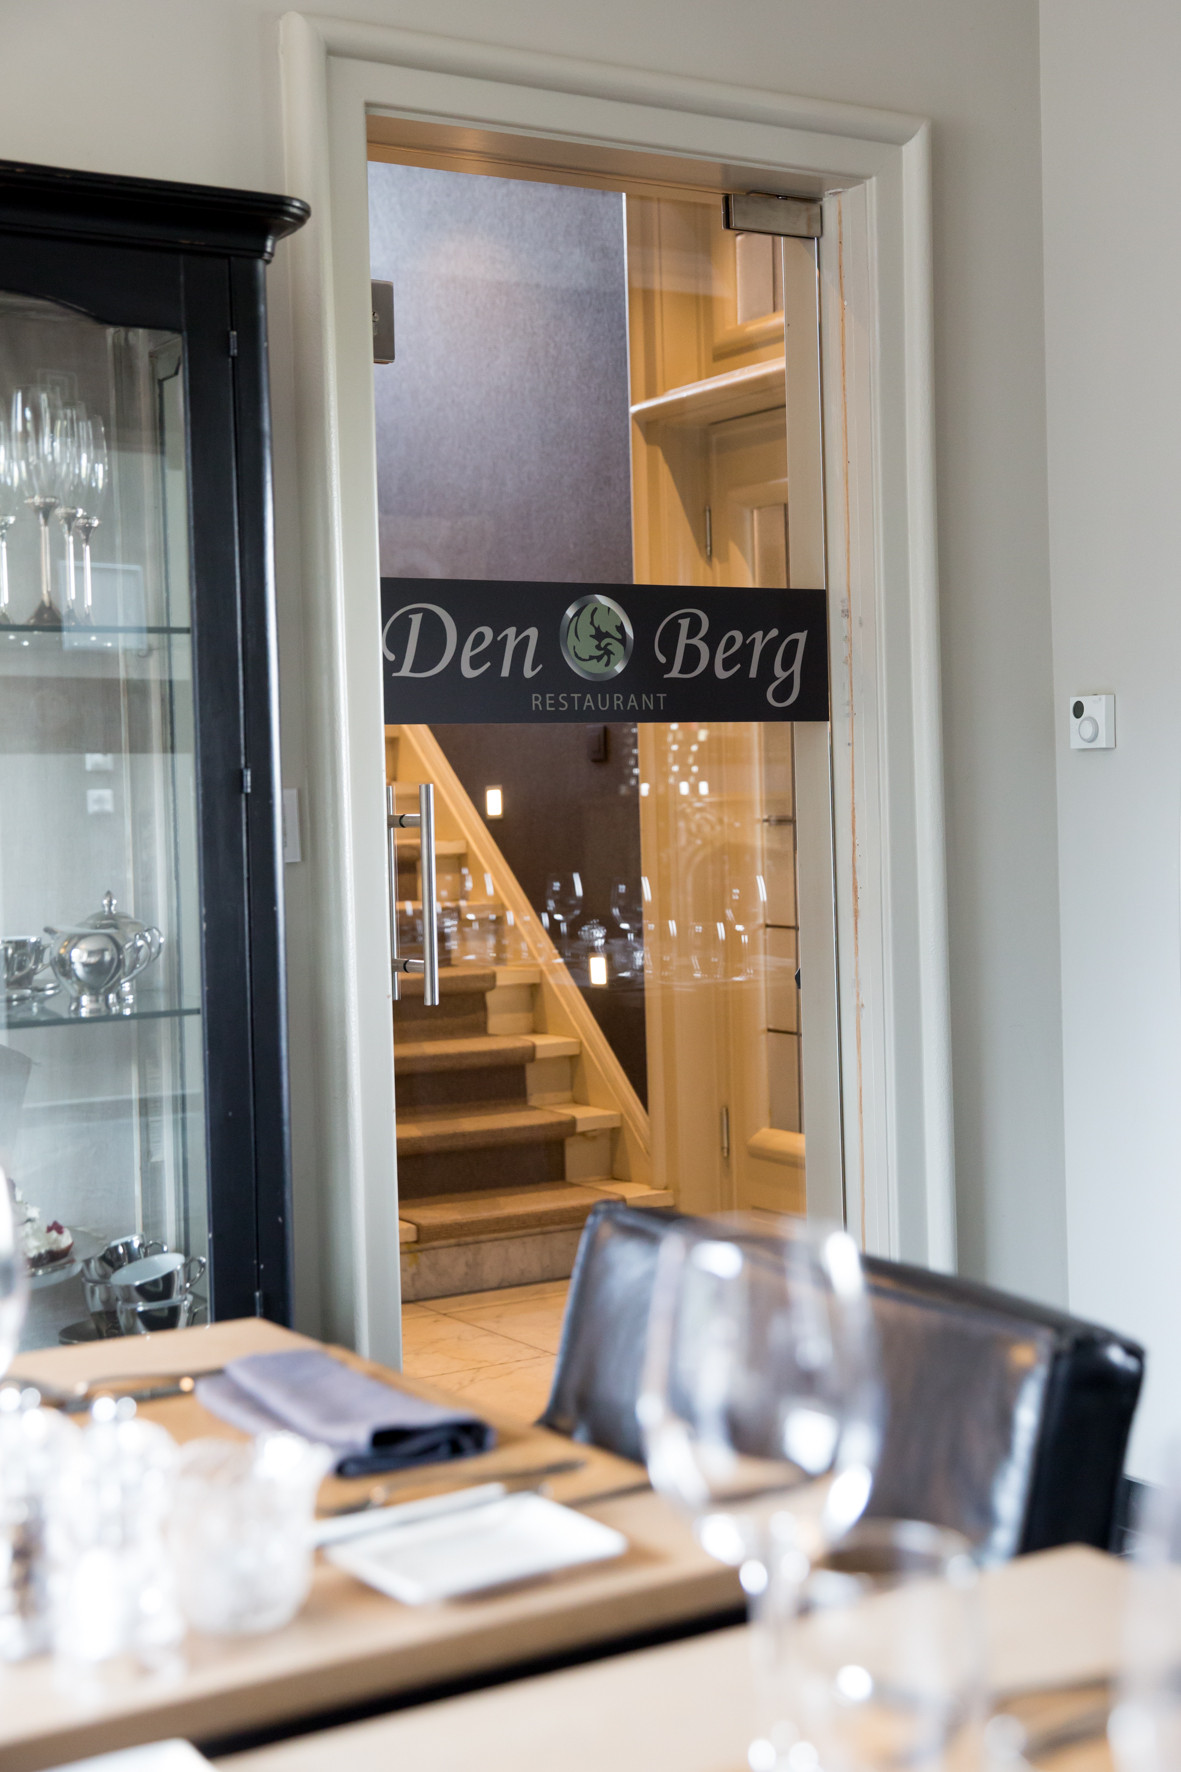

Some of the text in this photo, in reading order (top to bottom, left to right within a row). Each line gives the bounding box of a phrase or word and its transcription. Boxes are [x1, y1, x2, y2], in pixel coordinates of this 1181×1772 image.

[382, 602, 808, 708] Den Berg
[531, 693, 668, 711] RESTAURANT
